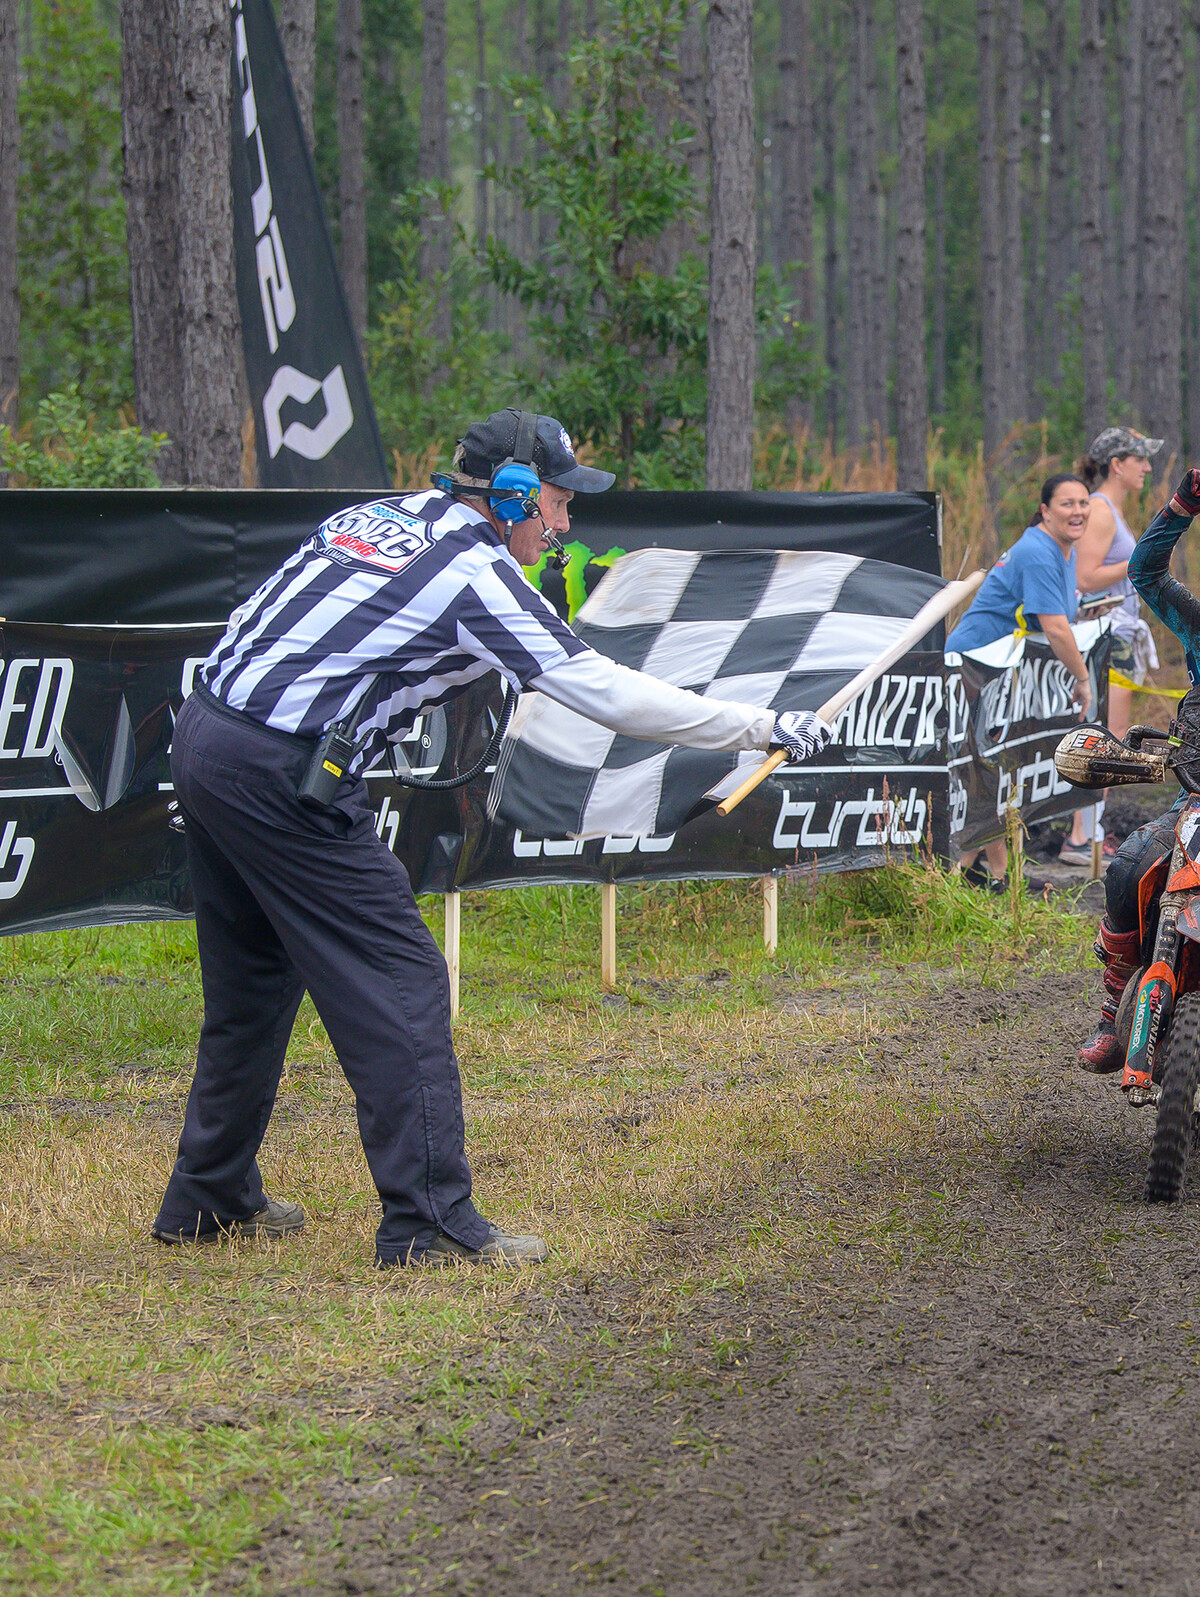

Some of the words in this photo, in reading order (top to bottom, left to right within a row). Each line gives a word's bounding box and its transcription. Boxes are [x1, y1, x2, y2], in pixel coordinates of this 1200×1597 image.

[327, 512, 424, 559] GNCC
[330, 534, 378, 558] RACING
[831, 675, 944, 747] ALIZED
[772, 787, 927, 849] turbo
[1131, 1004, 1147, 1050] MOTOREX
